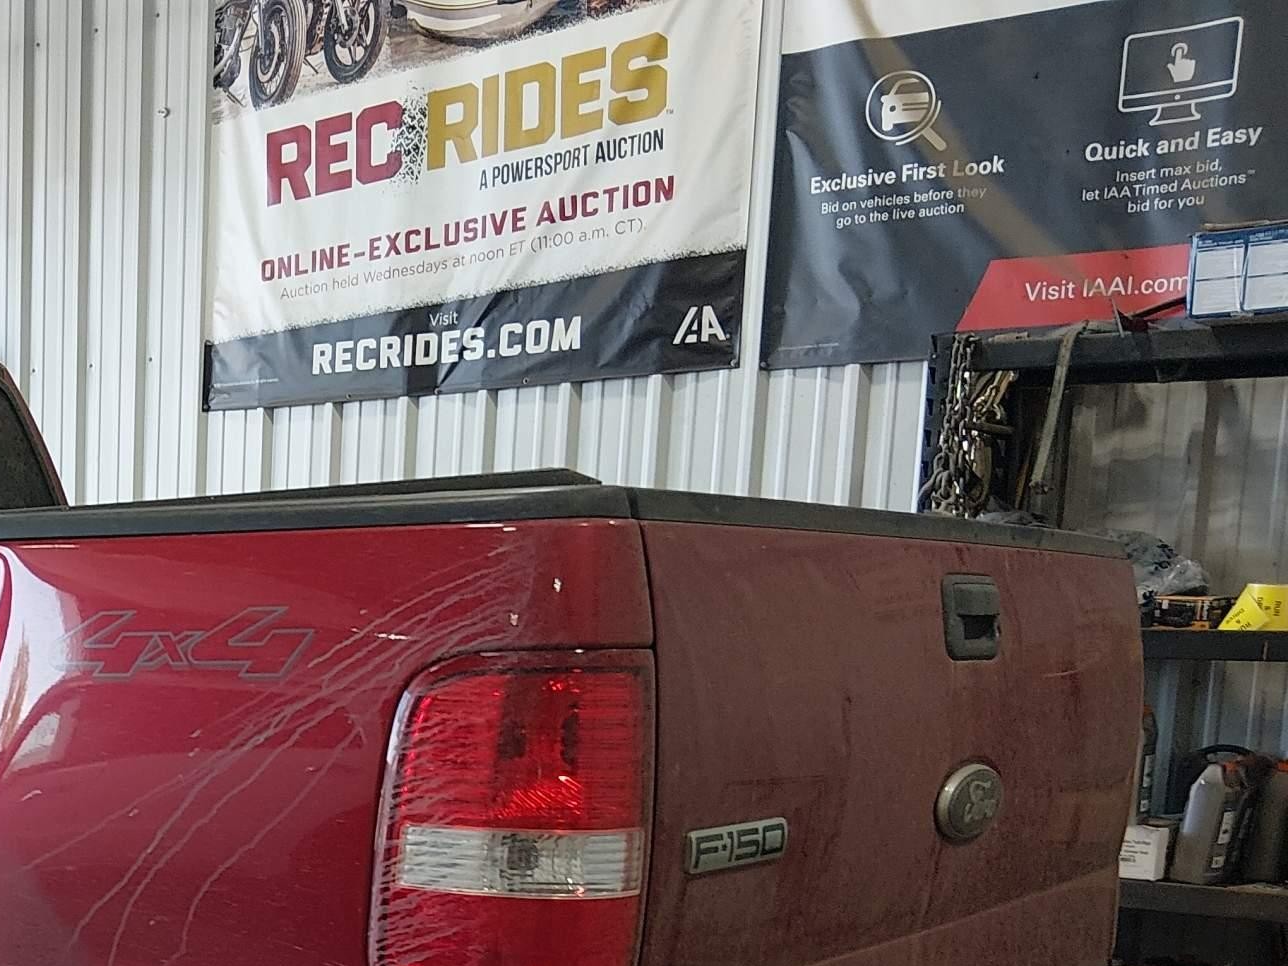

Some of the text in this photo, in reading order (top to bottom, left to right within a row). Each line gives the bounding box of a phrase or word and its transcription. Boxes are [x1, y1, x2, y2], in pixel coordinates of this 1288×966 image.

[266, 101, 403, 207] REC
[426, 31, 669, 172] RIDES
[479, 127, 665, 190] A POWERSPORT AUCTION
[1084, 125, 1264, 163] Quick and Easy
[809, 154, 1006, 195] Exclusive First Look
[1081, 172, 1247, 202] let IAA Timed Auctions
[1115, 158, 1223, 183] Insert max bid,
[821, 186, 988, 215] Bid on vehicles before they
[835, 202, 965, 230] go to the live auction
[1127, 195, 1205, 213] bid for you
[260, 175, 675, 282] ONLINE-EXCLUSIVE AUCTION
[279, 282, 328, 300] Auction
[332, 273, 359, 291] held
[363, 257, 448, 283] Wednesdays
[452, 254, 466, 268] at
[469, 242, 505, 264] noon
[509, 239, 526, 257] ET
[530, 230, 574, 253] (11:00
[578, 224, 609, 242] a.m.
[1025, 273, 1189, 301] Visit IAAI.com
[428, 311, 459, 328] Visit
[311, 315, 582, 375] RECRIDES.COM
